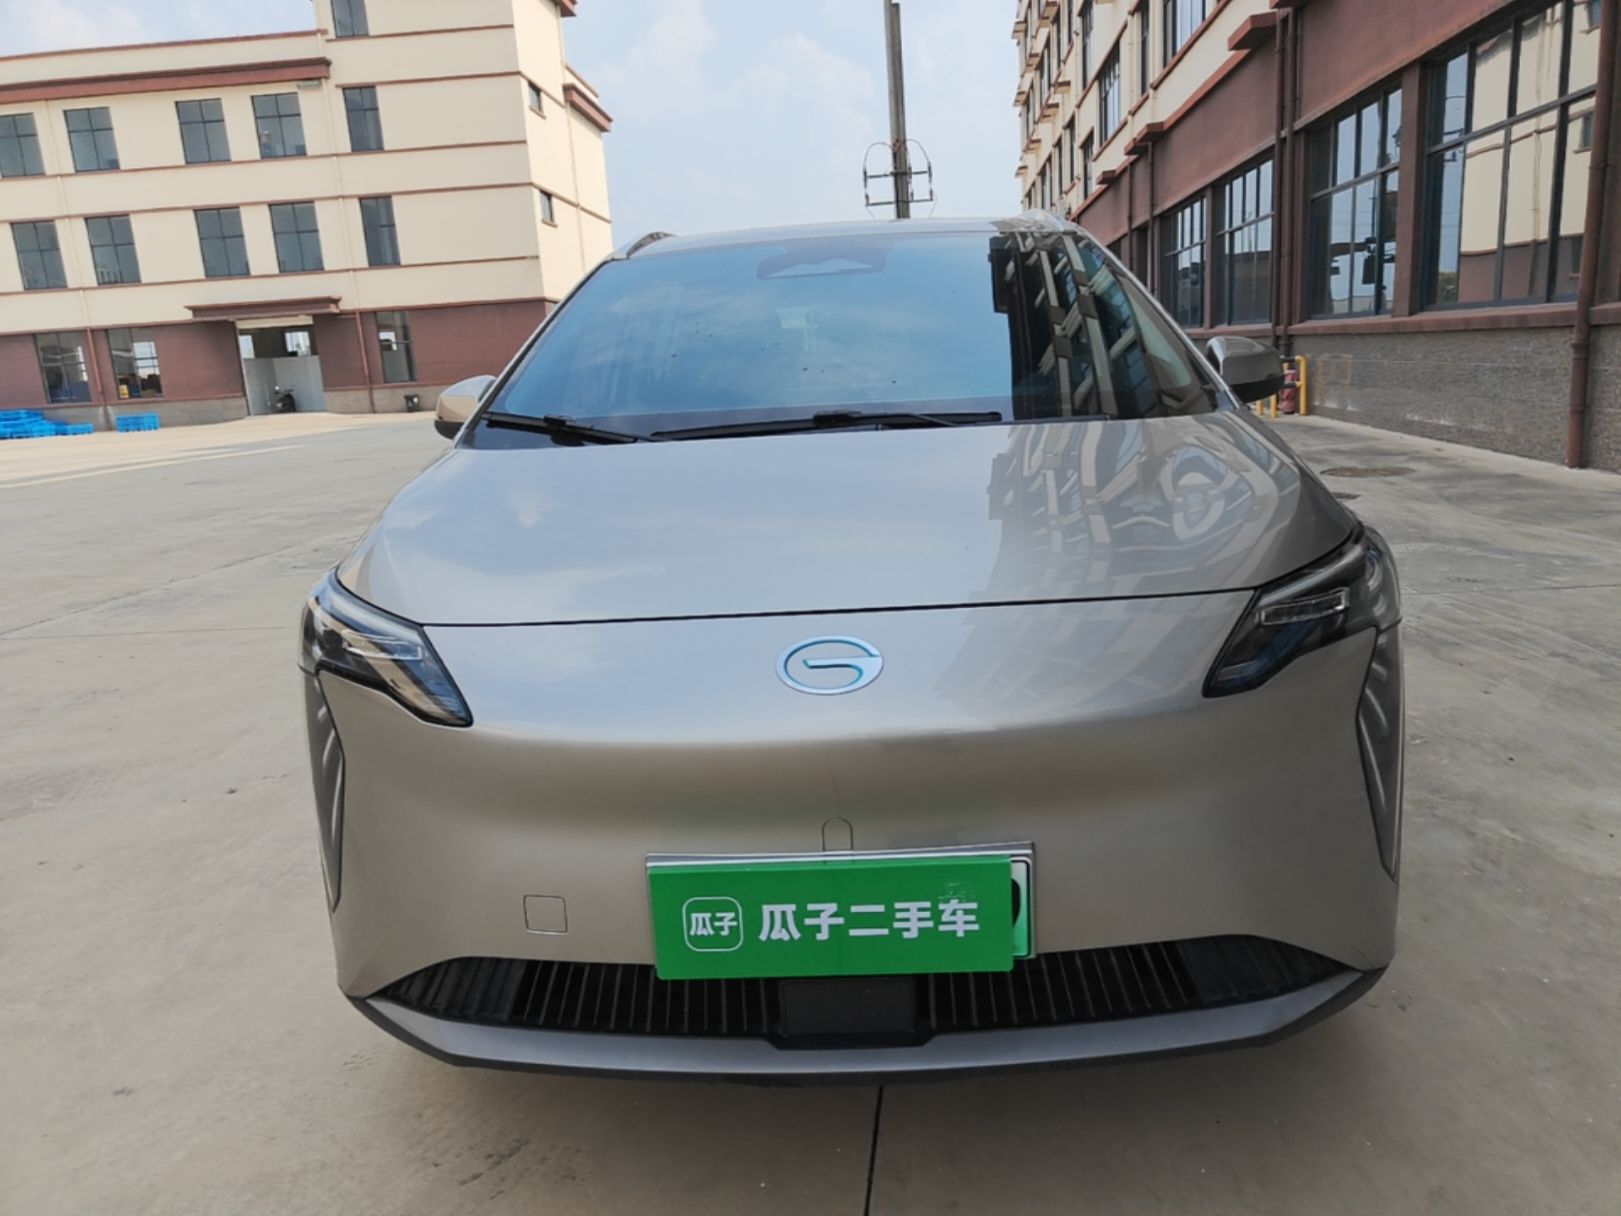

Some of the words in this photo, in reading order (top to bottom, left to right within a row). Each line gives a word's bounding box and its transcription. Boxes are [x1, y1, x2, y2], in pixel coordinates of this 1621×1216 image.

[689, 911, 738, 936] 瓜子
[759, 900, 980, 941] 瓜子二手车
